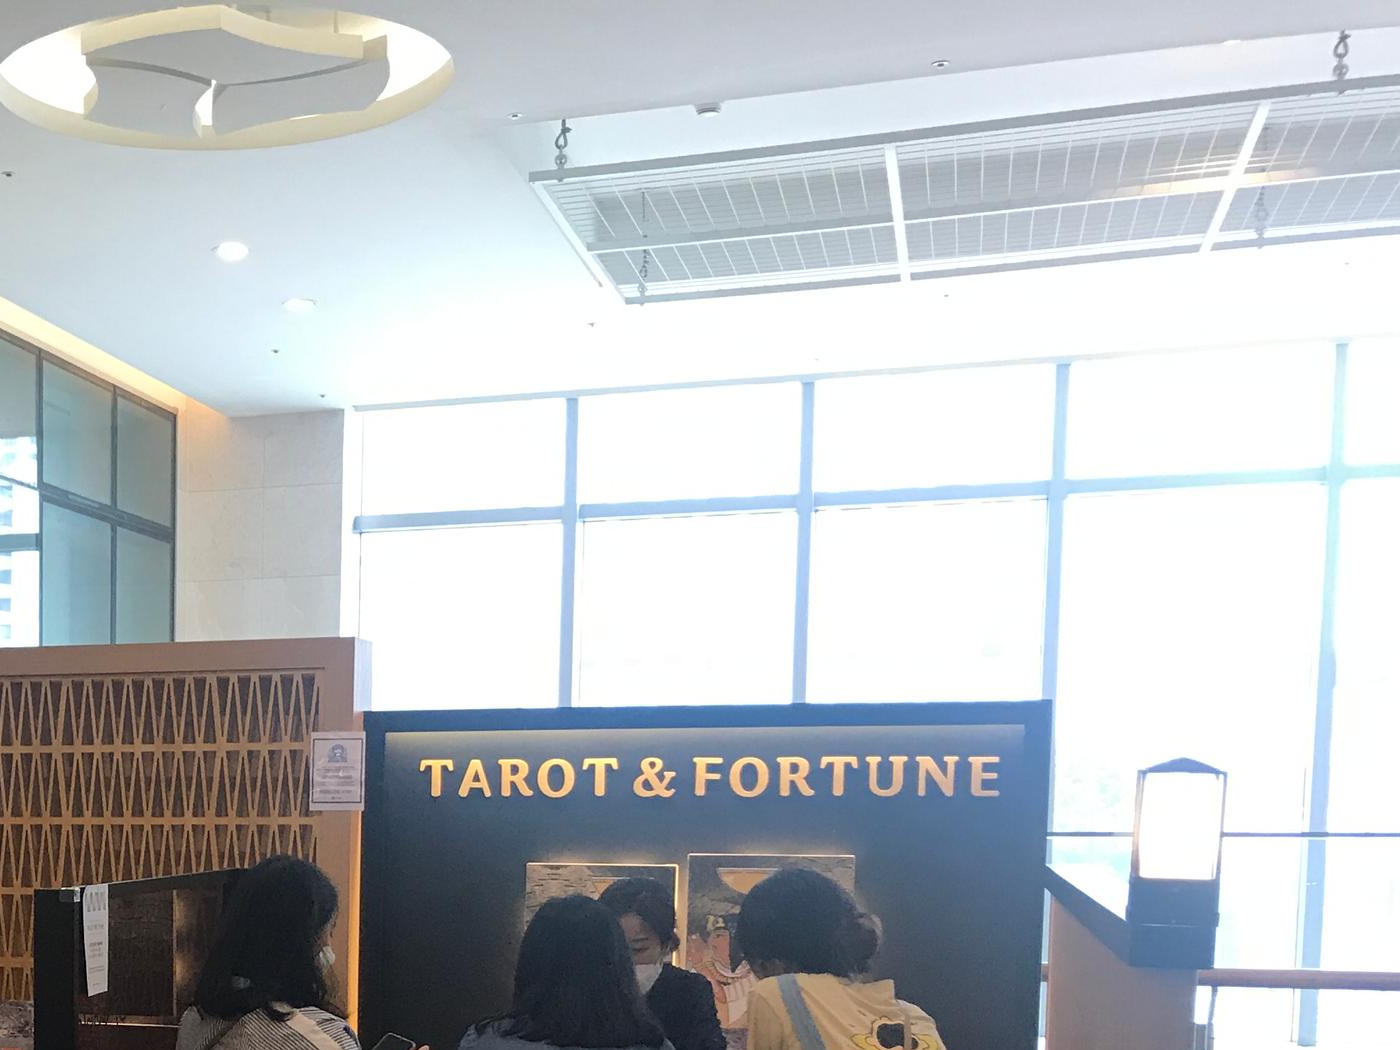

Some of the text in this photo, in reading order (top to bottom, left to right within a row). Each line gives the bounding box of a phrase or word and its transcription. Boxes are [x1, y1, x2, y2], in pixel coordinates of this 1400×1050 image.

[419, 756, 1000, 798] TAROT & FORTUNE
